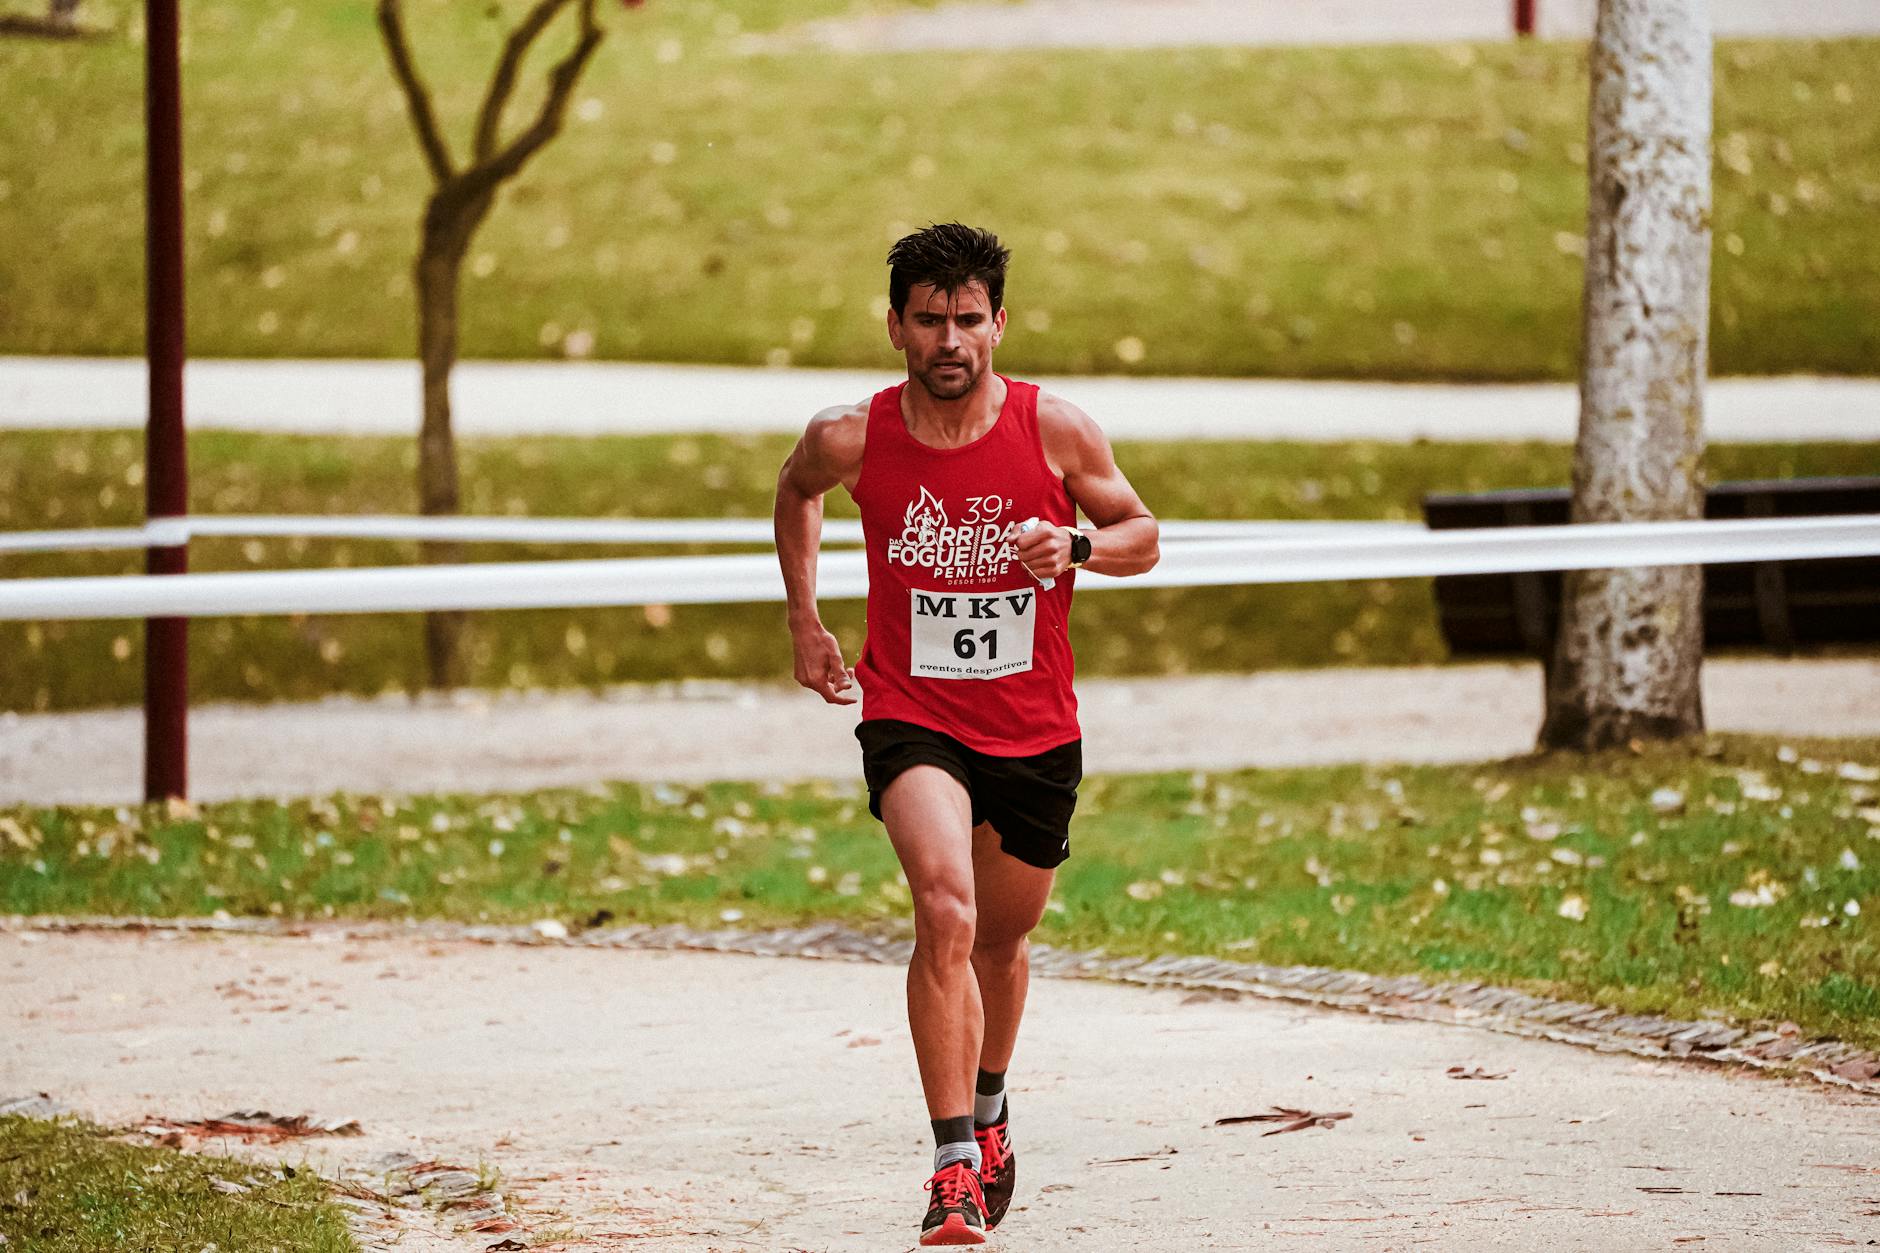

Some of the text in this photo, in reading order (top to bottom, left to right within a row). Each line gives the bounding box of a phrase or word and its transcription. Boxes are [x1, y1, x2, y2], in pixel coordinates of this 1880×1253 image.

[888, 538, 904, 547] DAS
[933, 562, 1009, 579] PENICHE
[947, 578, 975, 586] DESDE
[953, 628, 998, 660] 61
[919, 659, 1028, 675] eventos desportivos
